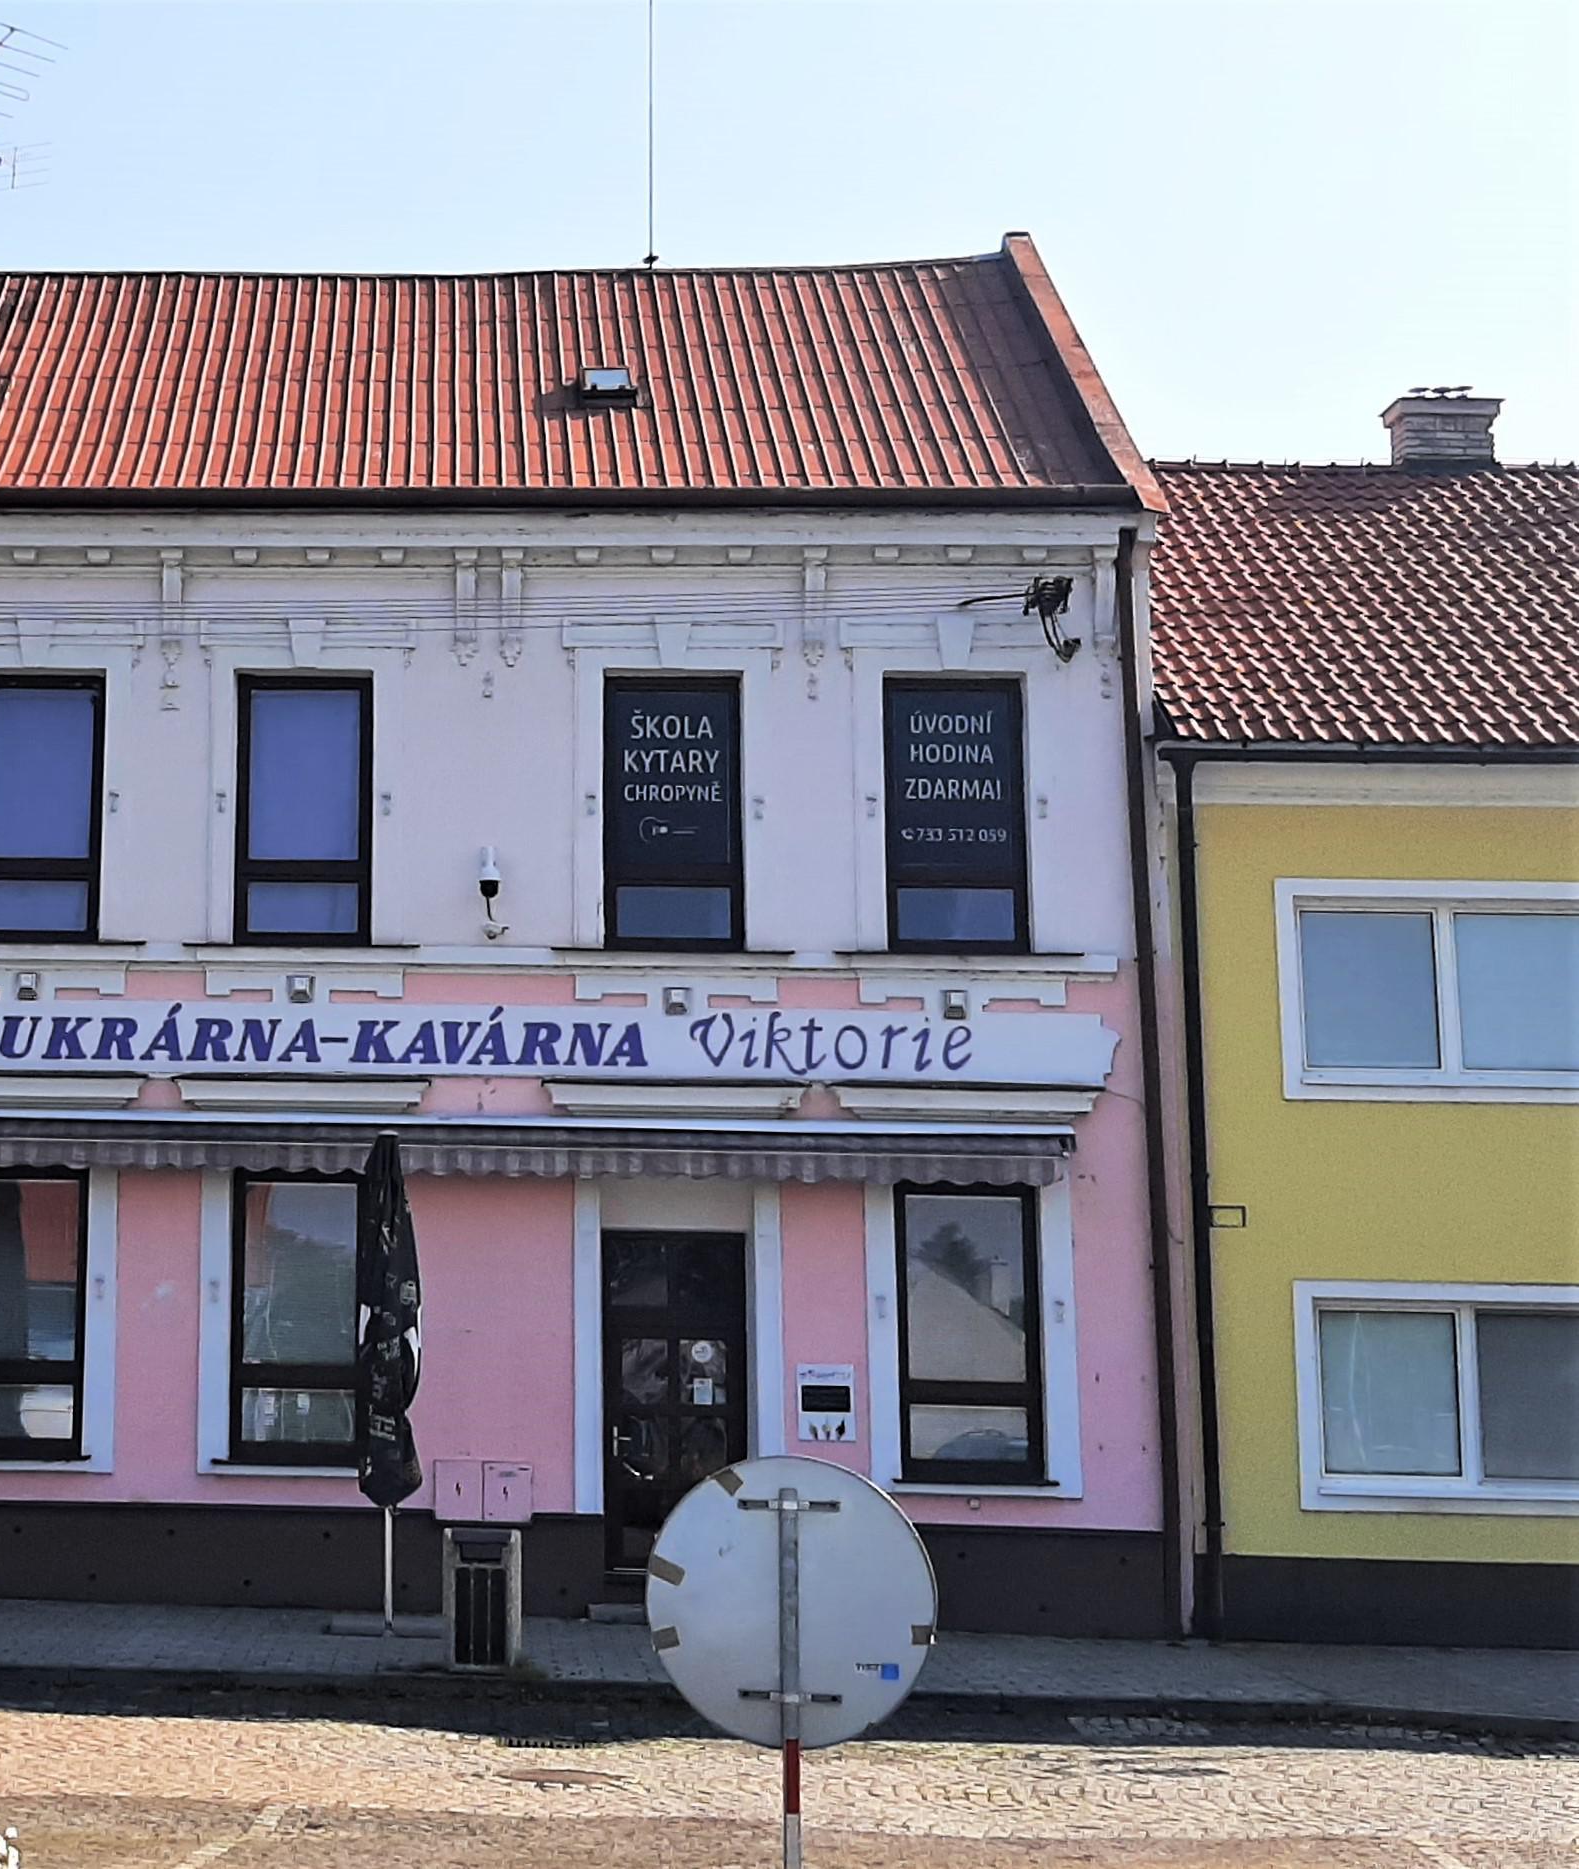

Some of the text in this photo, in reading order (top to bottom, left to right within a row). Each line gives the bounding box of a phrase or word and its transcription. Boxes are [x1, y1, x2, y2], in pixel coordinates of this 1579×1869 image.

[630, 708, 714, 739] ŠKOLA
[909, 710, 994, 735] ÚVODNÍ
[623, 749, 721, 774] KYTARY
[909, 743, 995, 765] HODINA
[623, 780, 724, 802] CHROPYNĚ
[978, 827, 1008, 842] 059
[688, 1010, 974, 1076] Viktorie
